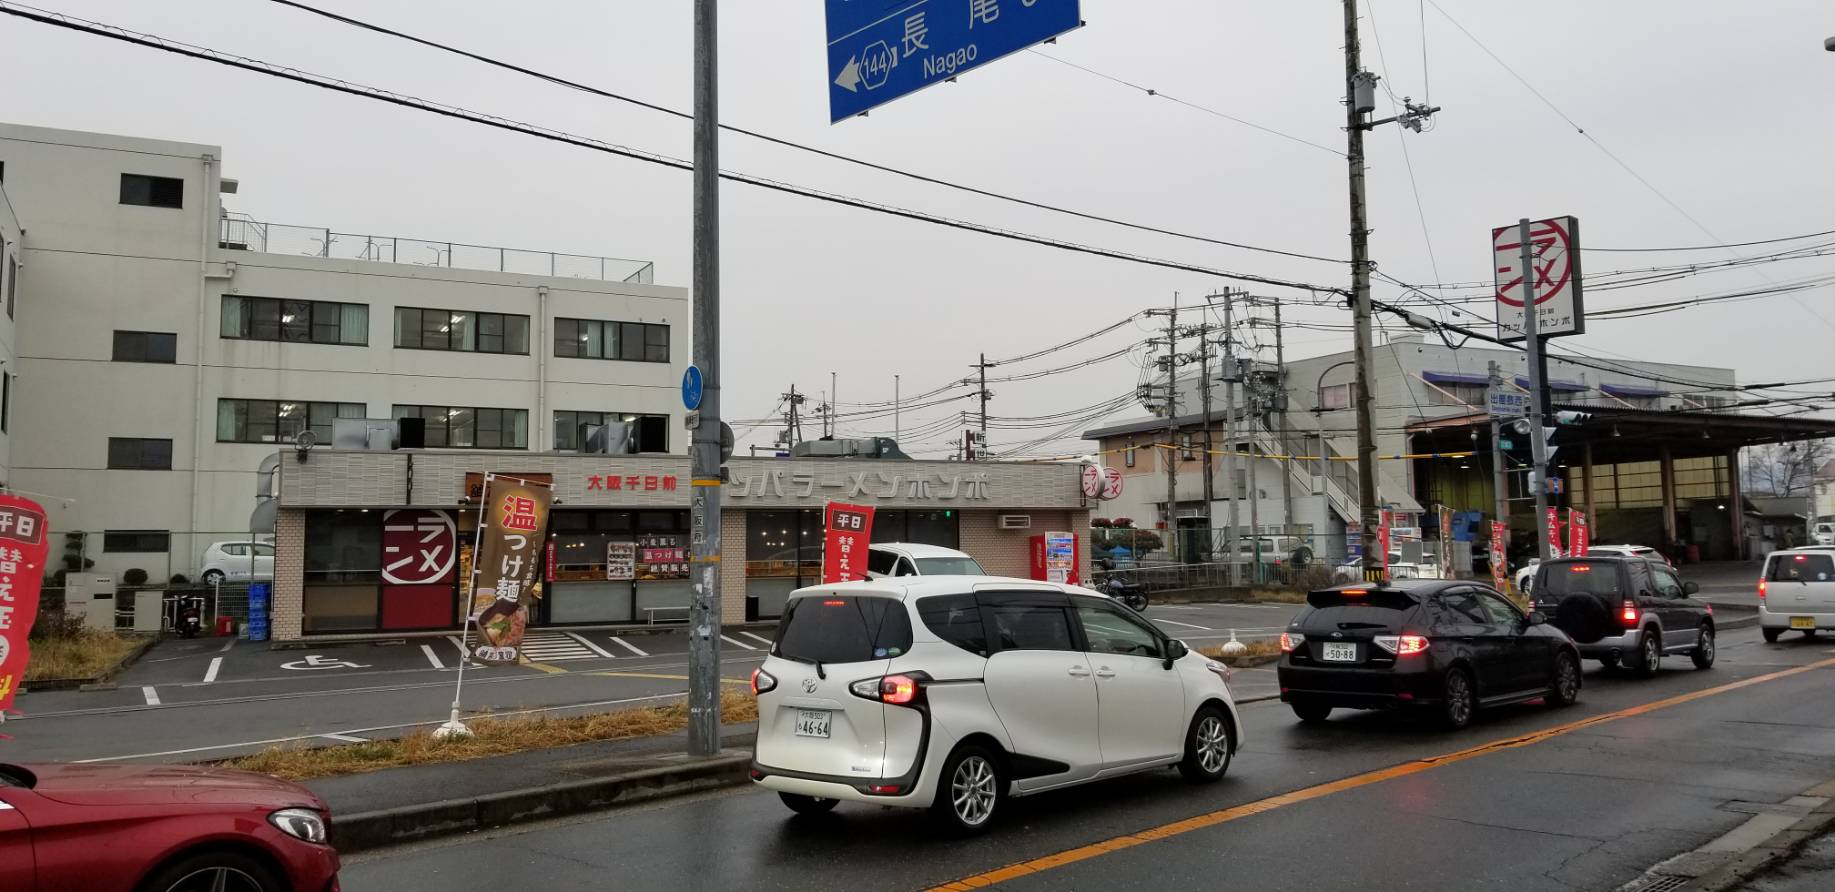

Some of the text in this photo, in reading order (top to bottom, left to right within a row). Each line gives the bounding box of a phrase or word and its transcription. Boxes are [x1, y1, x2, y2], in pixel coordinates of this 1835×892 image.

[864, 53, 887, 79] 144
[923, 44, 978, 79] Nagao
[587, 475, 678, 491] 大阪千日前
[837, 513, 862, 529] 平日
